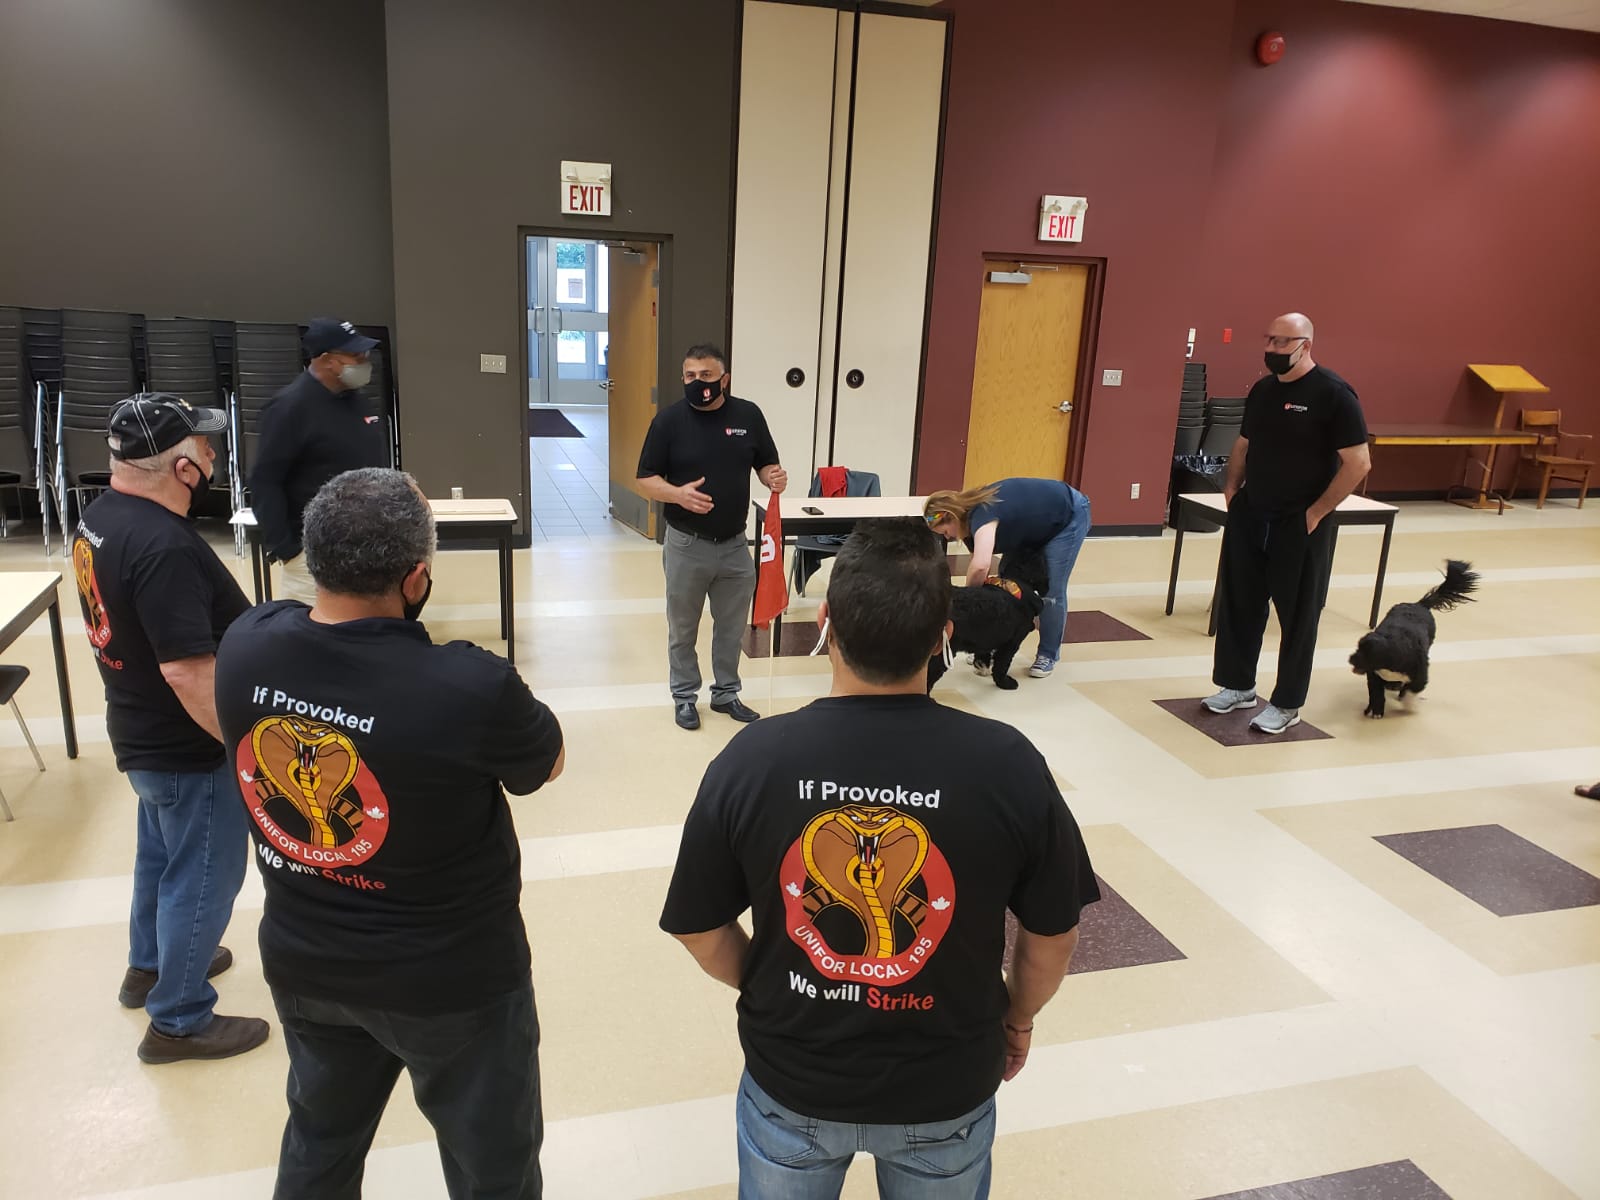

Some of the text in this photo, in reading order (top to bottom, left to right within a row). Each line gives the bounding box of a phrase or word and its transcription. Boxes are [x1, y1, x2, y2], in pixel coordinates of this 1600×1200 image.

[570, 185, 604, 212] EXIT
[1049, 215, 1077, 239] EXIT
[252, 685, 375, 734] If Provoked
[798, 779, 941, 809] If Provoked
[254, 807, 373, 862] UNIFOR LOCAL 195
[258, 843, 386, 890] We will Strike
[794, 925, 933, 979] UNIFOR LOCAL 195
[788, 970, 935, 1011] We will Strike
